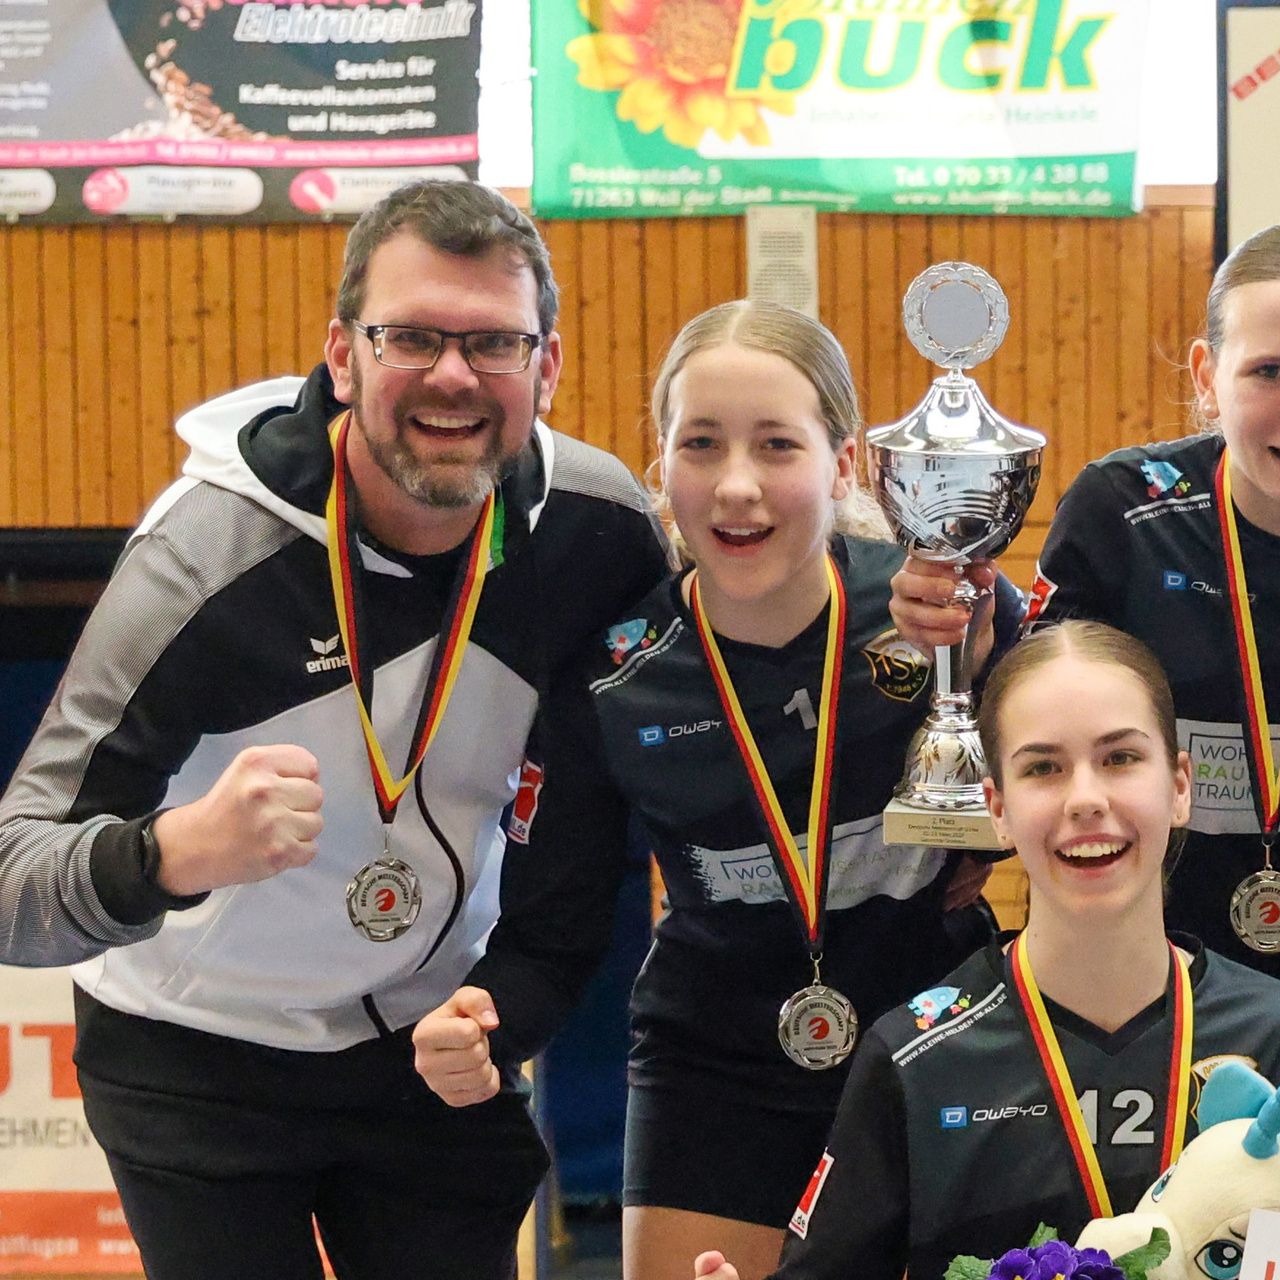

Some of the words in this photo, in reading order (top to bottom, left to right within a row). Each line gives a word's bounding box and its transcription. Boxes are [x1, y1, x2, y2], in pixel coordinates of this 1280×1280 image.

[335, 59, 405, 80] Service
[407, 55, 436, 76] für
[288, 111, 327, 131] und
[306, 654, 350, 674] erima
[783, 688, 818, 731] 1
[898, 992, 1008, 1067] WWW.KLEINE-HELDEN-IM-ALL.DE
[1077, 1089, 1155, 1145] 12
